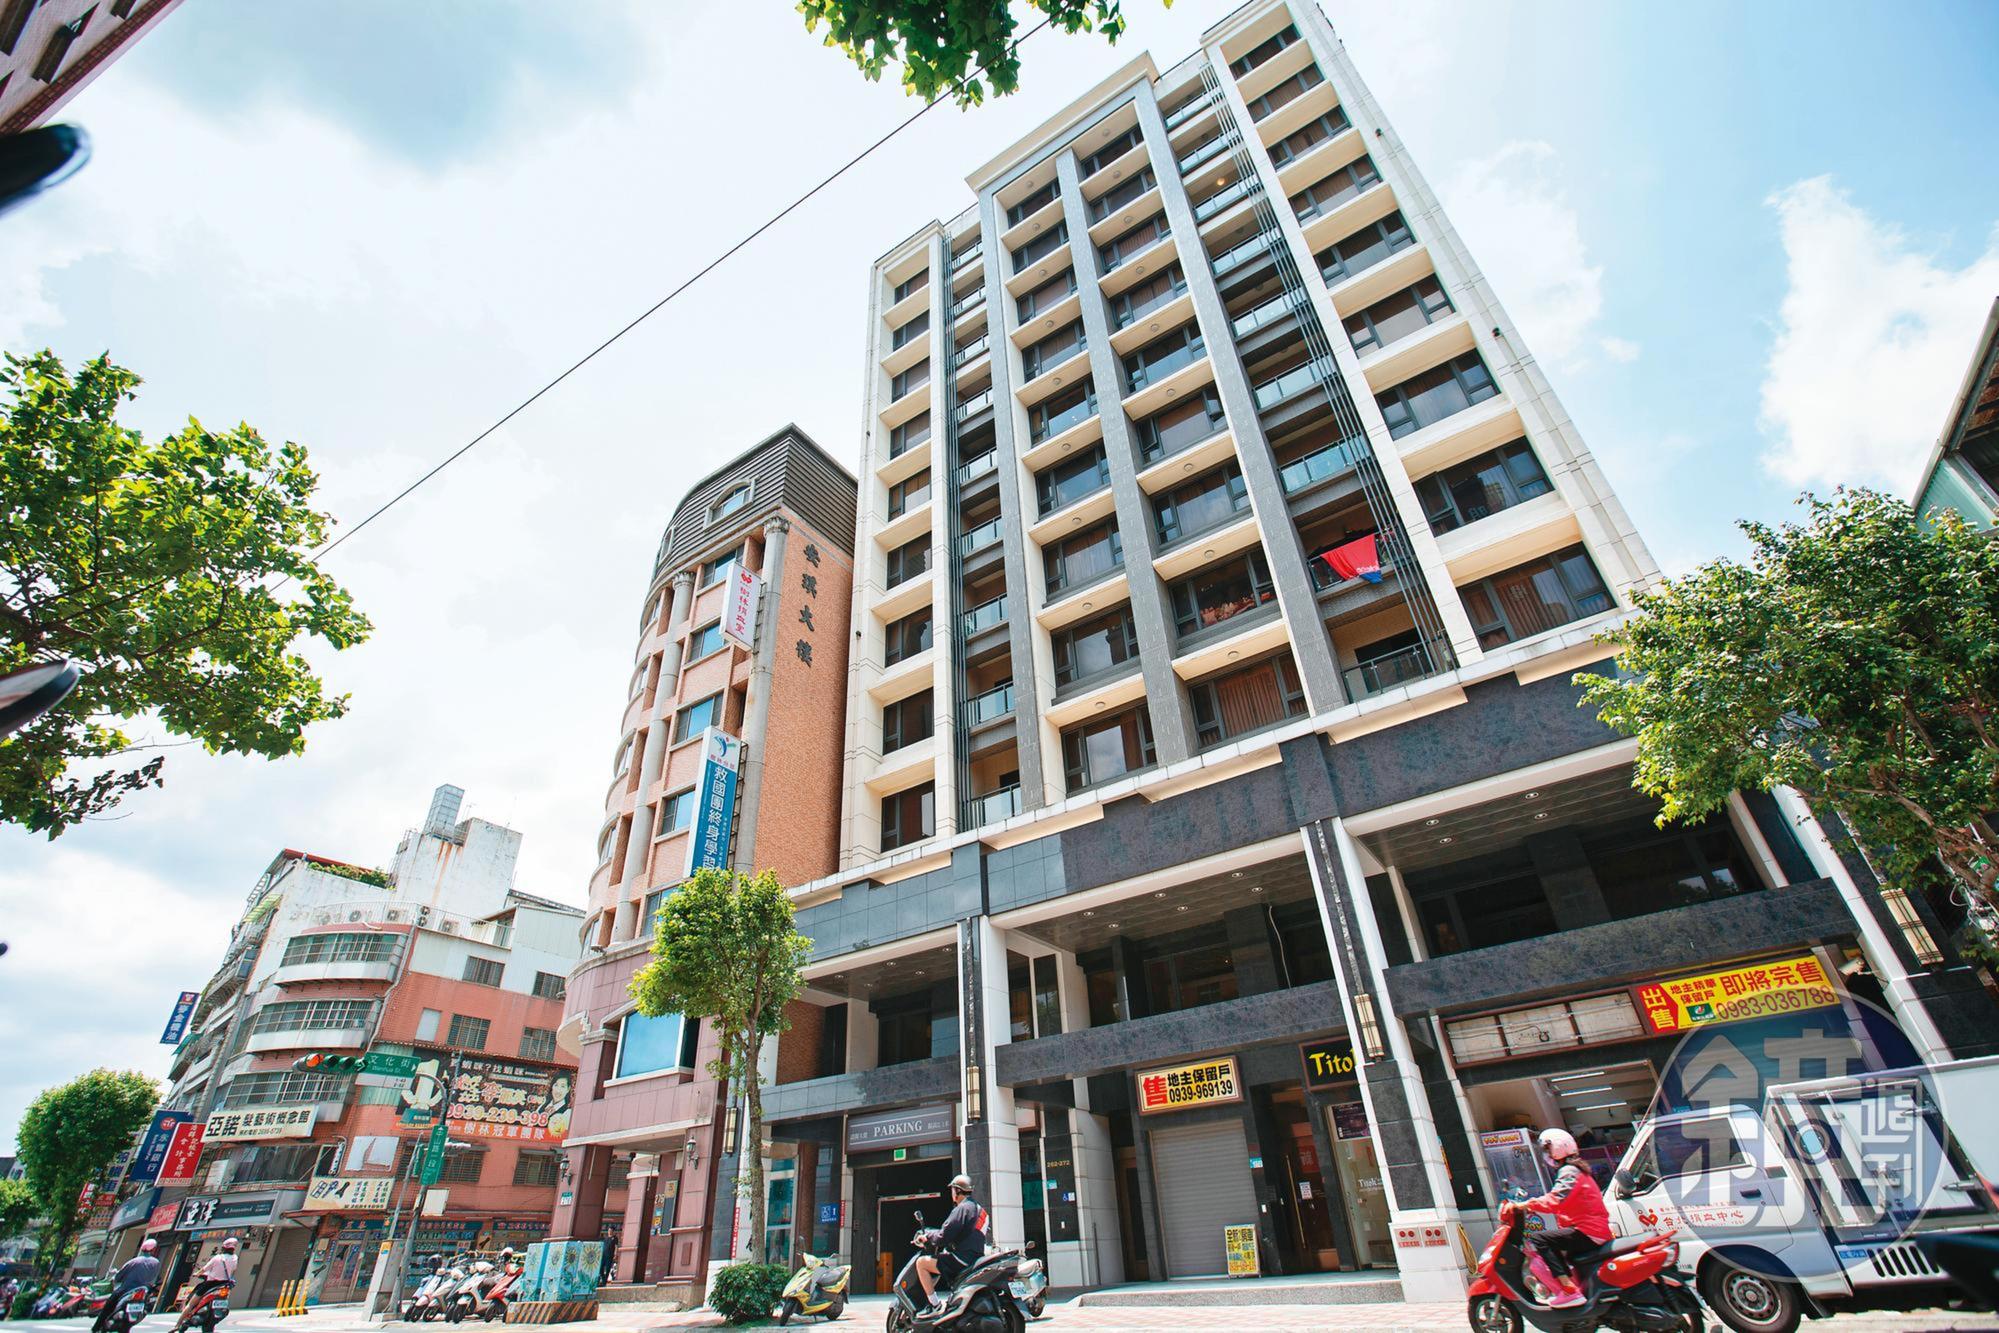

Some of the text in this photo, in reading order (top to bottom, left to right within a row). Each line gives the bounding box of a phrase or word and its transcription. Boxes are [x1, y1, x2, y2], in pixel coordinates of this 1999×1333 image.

[1719, 961, 1824, 997] 即將完售
[1680, 989, 1716, 1005] 保留戶
[1715, 985, 1836, 1021] 0983-036788
[1641, 988, 1676, 1030] 出售
[370, 1055, 411, 1068] 文化街
[1167, 1063, 1231, 1087] 地主保留戶
[1143, 1075, 1169, 1106] 售
[1168, 1081, 1233, 1104] 0939-969139
[206, 1115, 241, 1137] 亞諾
[873, 1120, 923, 1138] PARKING
[1662, 1209, 1745, 1227] 台北捐血中心
